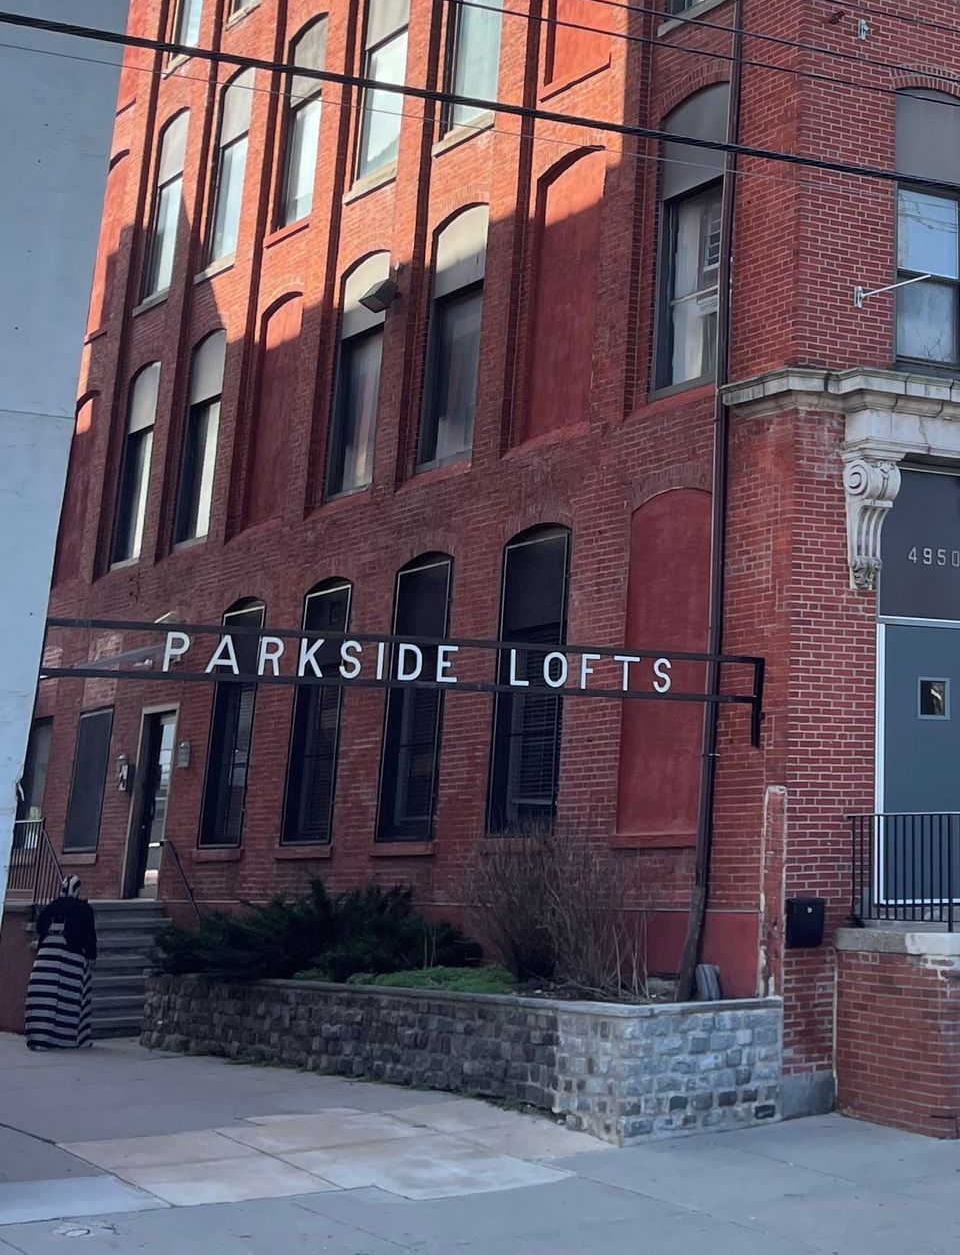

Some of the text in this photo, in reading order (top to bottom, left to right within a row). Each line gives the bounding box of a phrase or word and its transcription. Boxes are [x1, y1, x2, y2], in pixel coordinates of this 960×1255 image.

[908, 547, 960, 567] 4950
[162, 631, 672, 693] PARKSIDE LOFTS
